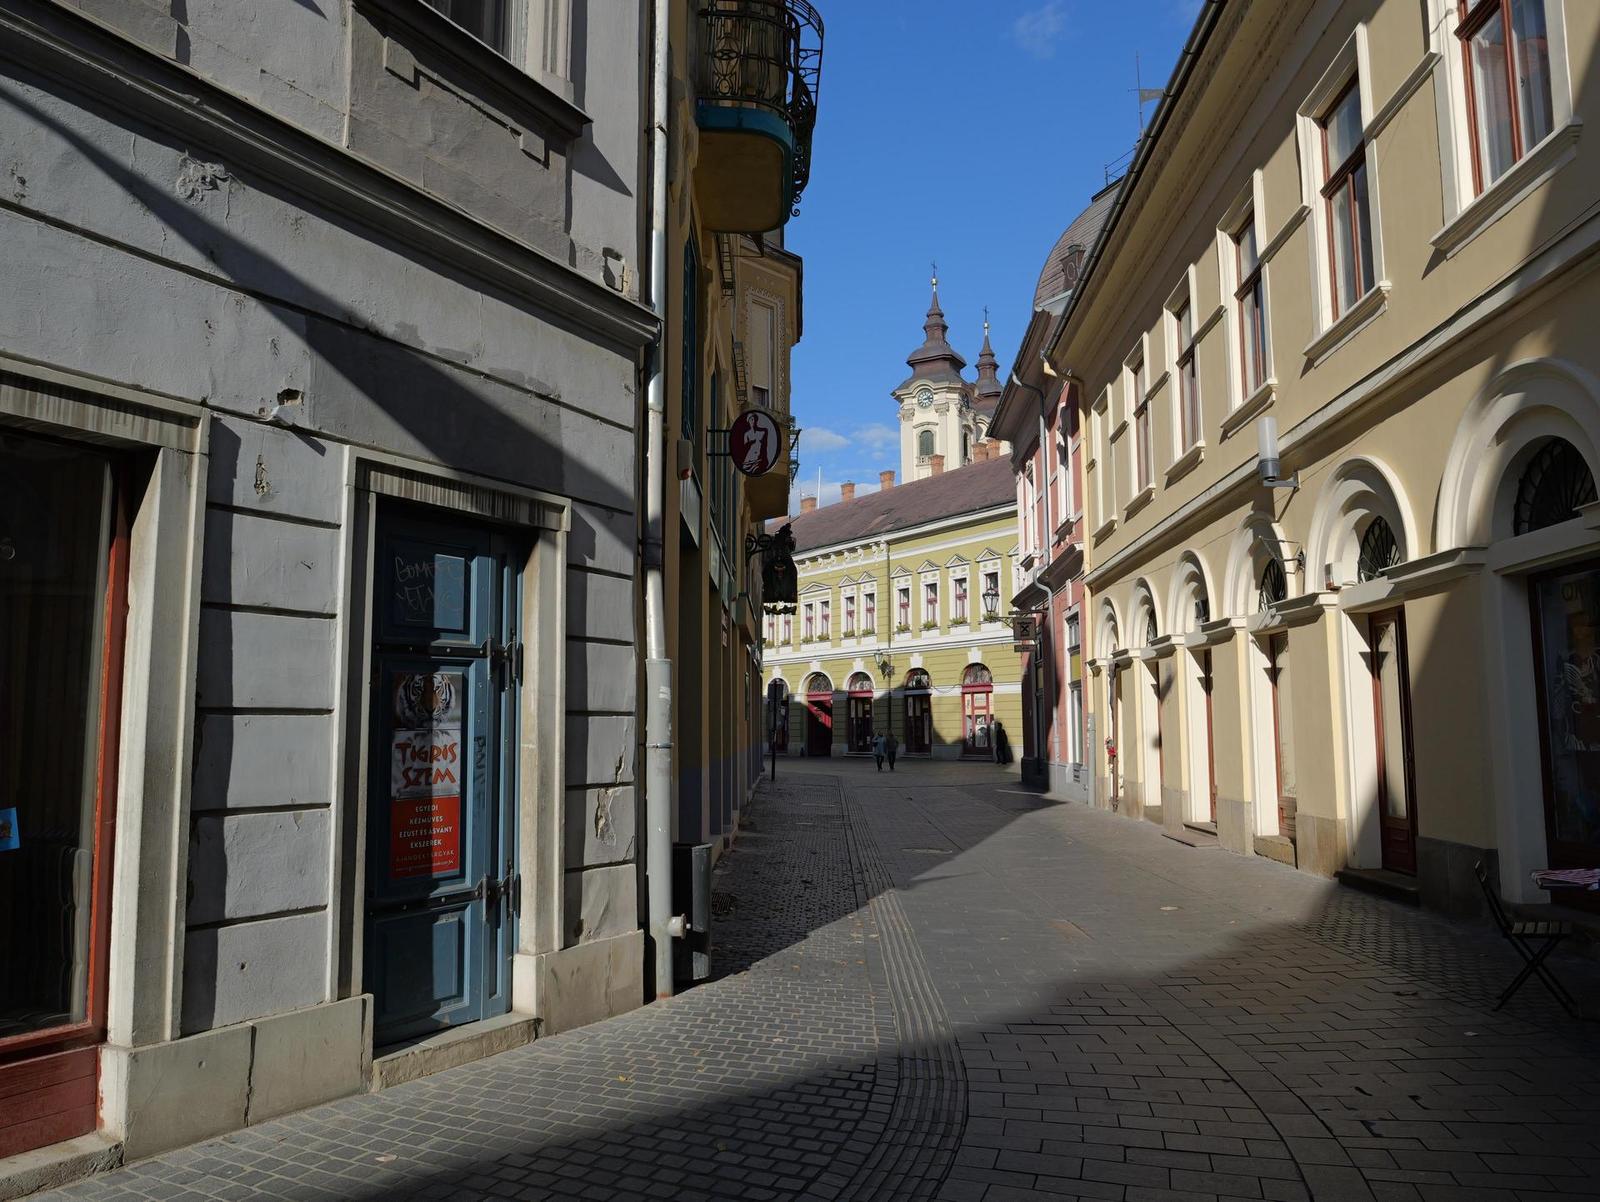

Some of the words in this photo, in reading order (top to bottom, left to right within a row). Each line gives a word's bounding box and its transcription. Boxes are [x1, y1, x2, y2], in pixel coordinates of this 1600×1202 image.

[395, 742, 458, 766] TIGRIS
[402, 767, 457, 789] SZEM
[415, 804, 439, 813] EGYEDI
